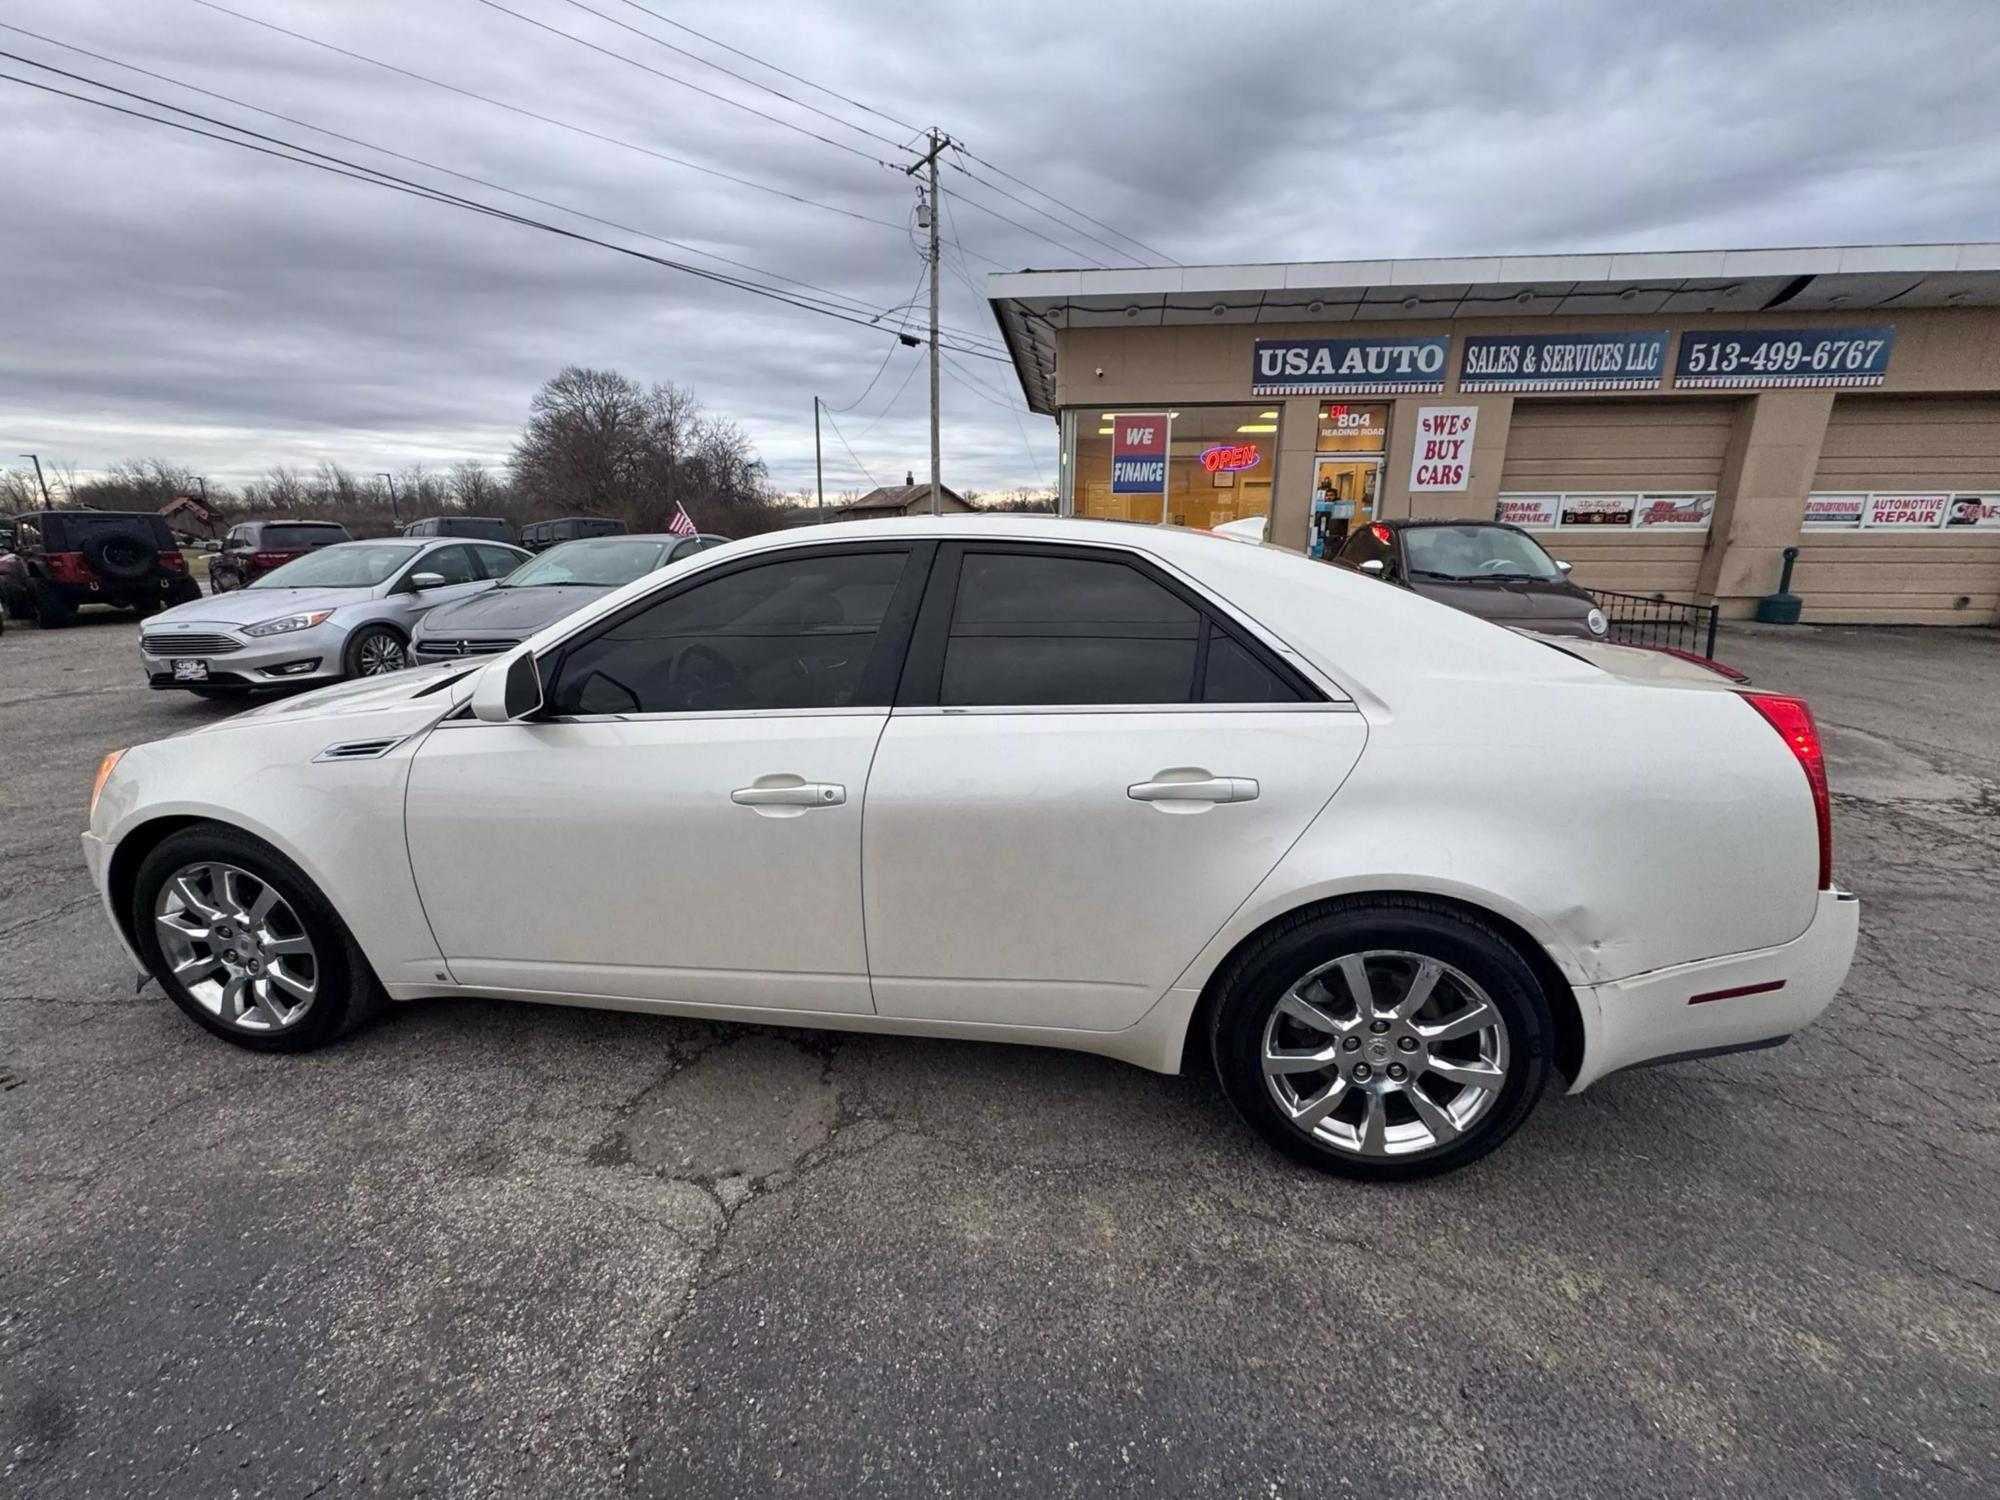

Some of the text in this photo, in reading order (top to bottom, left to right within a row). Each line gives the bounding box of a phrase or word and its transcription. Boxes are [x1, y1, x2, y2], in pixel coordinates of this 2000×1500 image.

[1259, 344, 1444, 376] USA AUTO
[1466, 342, 1660, 374] SALES & SERVICES LLC
[1688, 339, 1884, 371] 513-499-6767
[1337, 413, 1371, 427] 804
[1126, 428, 1155, 445] WE
[1321, 428, 1385, 436] READING ROAD
[1205, 445, 1257, 472] OPEN
[1424, 439, 1464, 460] BUY
[1114, 462, 1164, 482] FINANCE
[1416, 464, 1464, 485] CARS
[1502, 502, 1541, 512] BRAKE
[1873, 499, 1944, 510] AUTOMOTIVE
[1504, 513, 1552, 522] SERVICE
[1873, 511, 1936, 523] REPAIR
